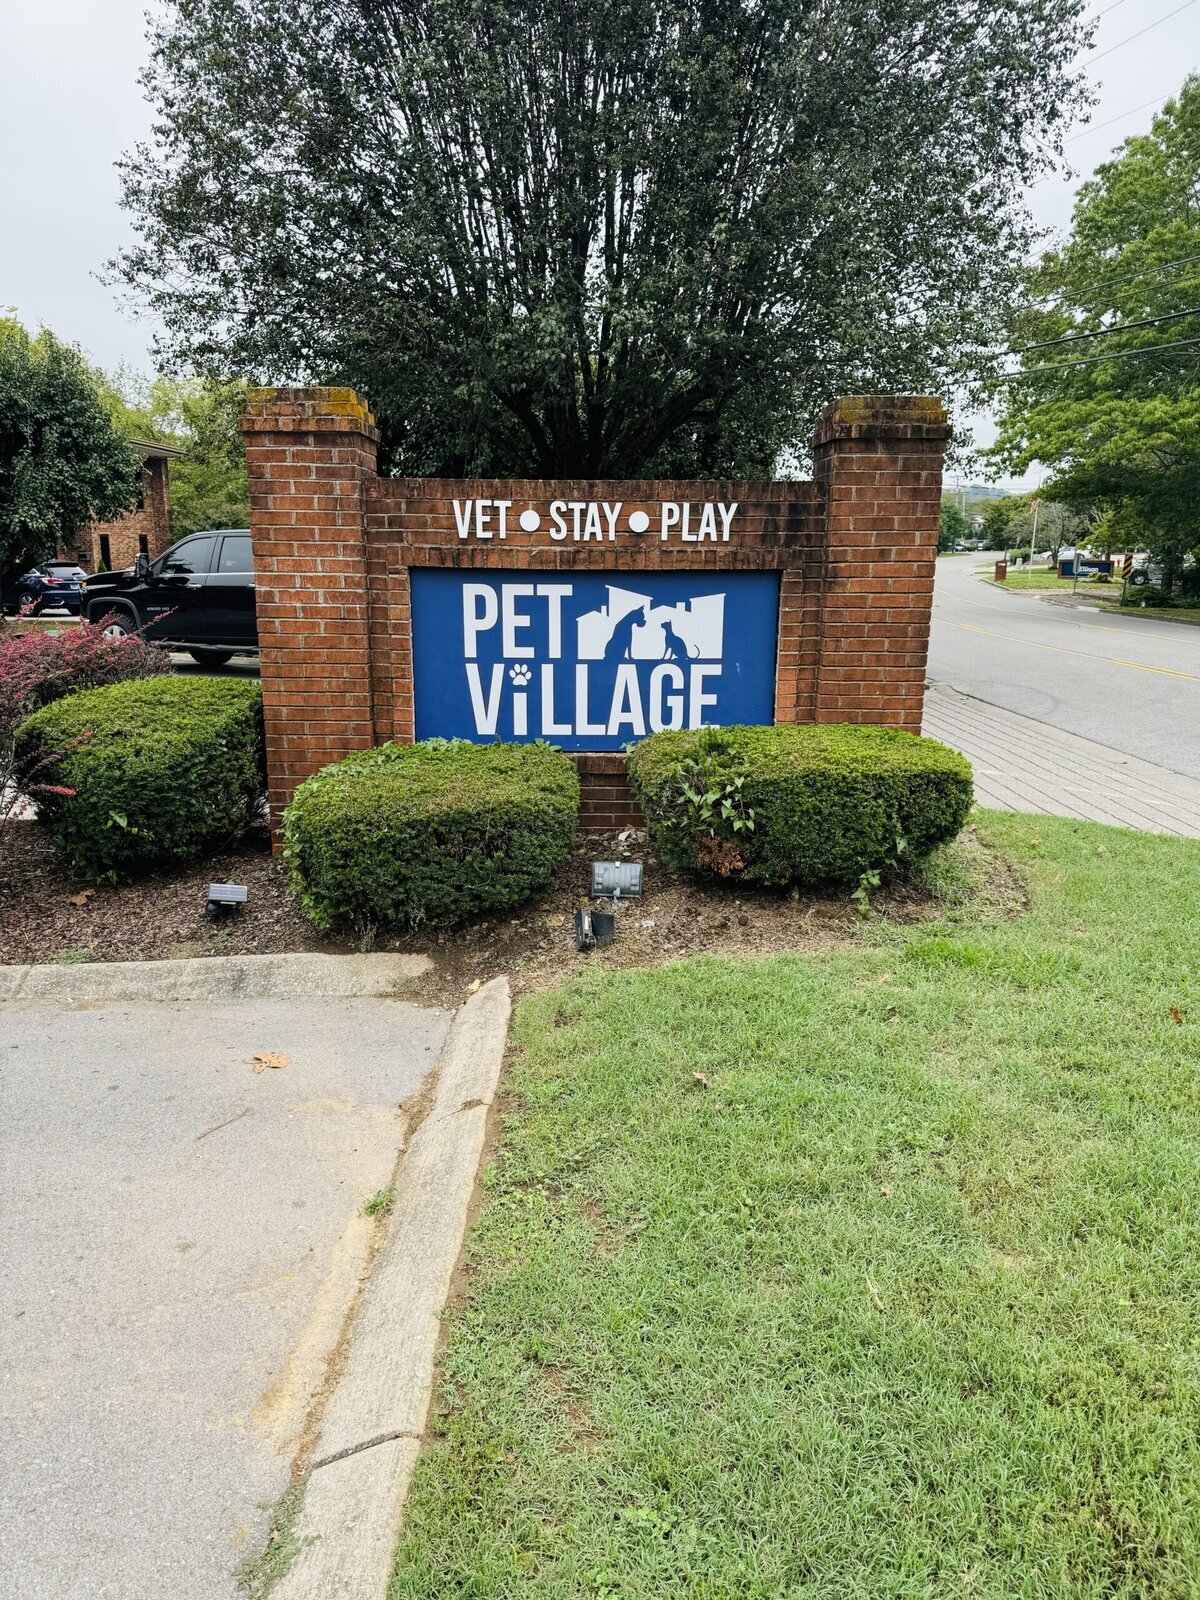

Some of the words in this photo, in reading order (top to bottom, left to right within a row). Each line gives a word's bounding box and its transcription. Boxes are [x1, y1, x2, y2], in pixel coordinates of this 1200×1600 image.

[452, 499, 512, 539] VET
[549, 500, 623, 542] STAY
[661, 501, 739, 542] PLAY
[462, 583, 573, 659] PET
